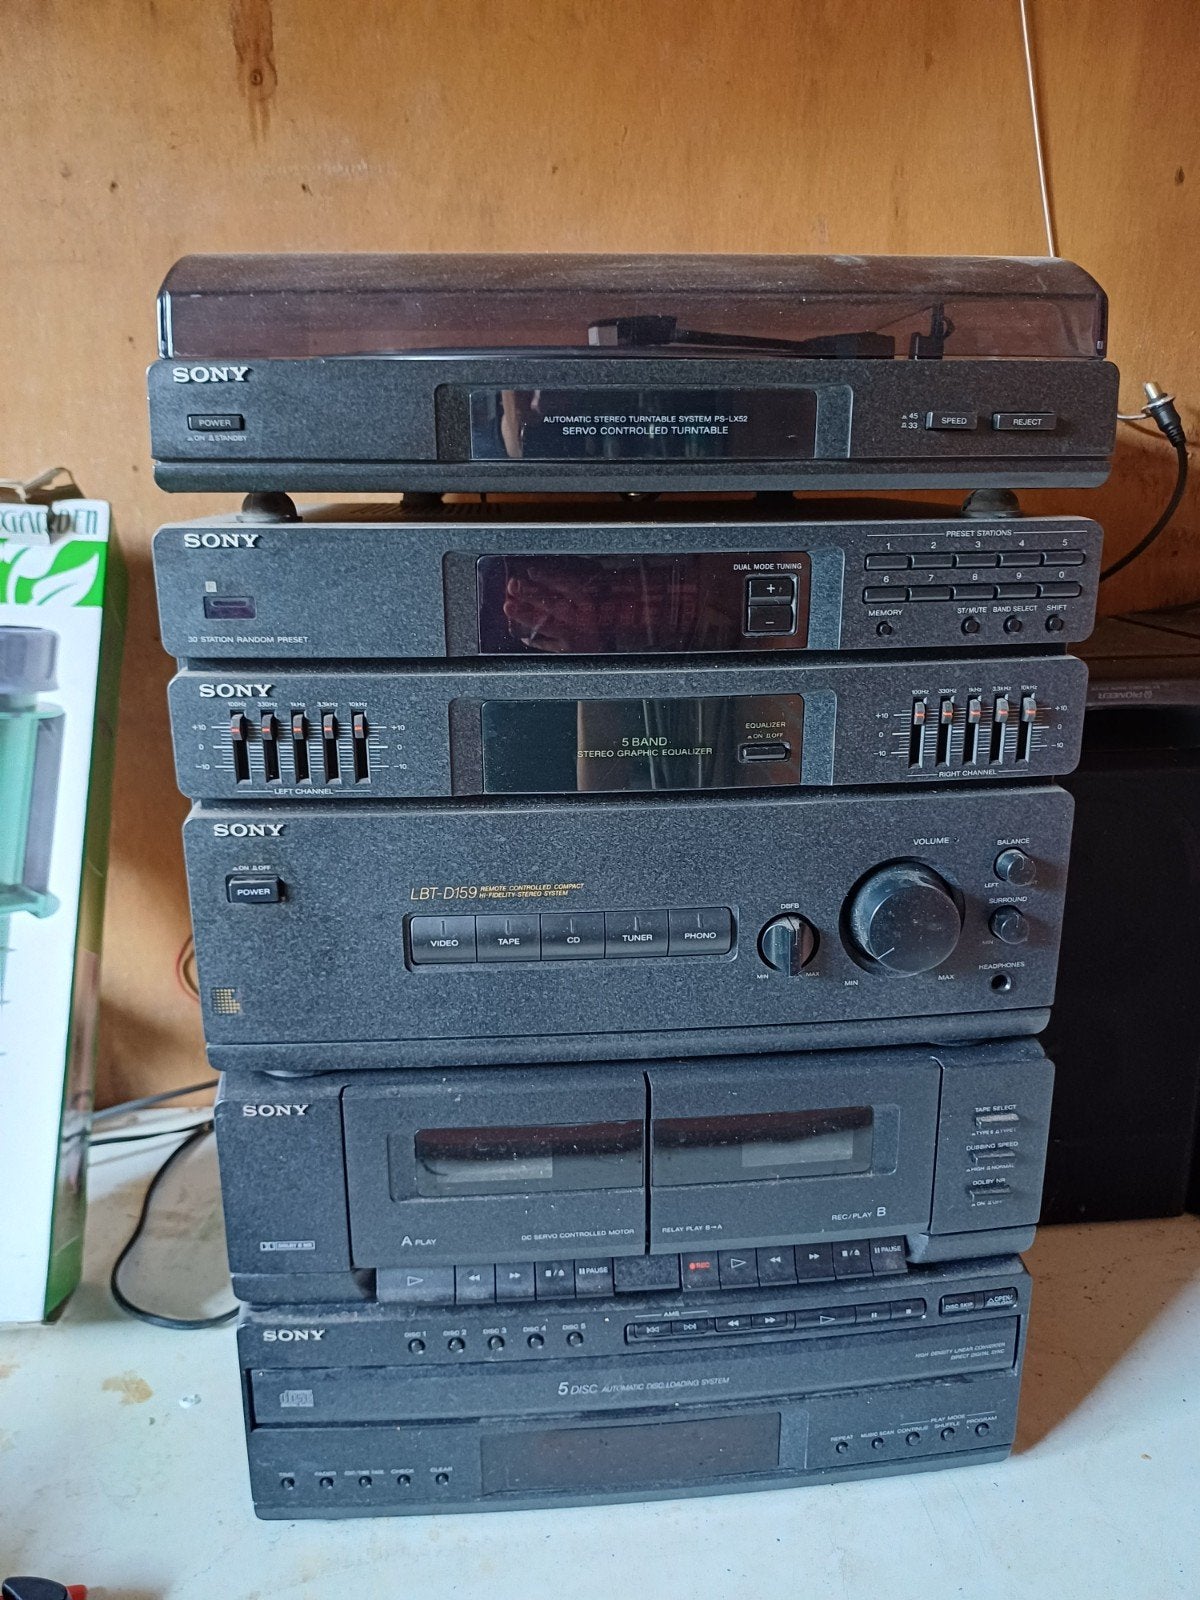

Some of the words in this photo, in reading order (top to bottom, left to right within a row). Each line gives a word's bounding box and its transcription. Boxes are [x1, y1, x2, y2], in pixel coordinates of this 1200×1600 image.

[172, 366, 250, 383] SONY
[942, 417, 968, 425] SPEED
[562, 426, 597, 435] SERVO
[600, 426, 668, 434] CONTROLLED
[671, 426, 728, 434] TURNTABLE
[184, 533, 260, 548] SONY
[199, 684, 272, 698] SONY
[622, 737, 629, 746] 5
[632, 736, 668, 747] BAND
[577, 750, 614, 758] STEREO
[616, 748, 659, 758] GRAPHIC
[662, 748, 713, 756] EQUALIZER
[213, 824, 284, 837] SONY
[913, 836, 950, 846] VOLUME
[996, 838, 1030, 846] BALANCE
[410, 886, 478, 900] LBT-D159
[988, 896, 1028, 904] SURROUND
[622, 934, 653, 942] TUNER
[684, 932, 717, 940] PHONO
[978, 961, 1026, 970] HEADPHONES
[242, 1104, 309, 1117] SONY
[832, 1211, 872, 1222] REC/PLAY
[876, 1206, 887, 1217] B
[534, 1232, 558, 1240] SERVO
[559, 1230, 606, 1239] CONTROLLED
[401, 1236, 412, 1246] A
[415, 1238, 437, 1246] PLAY
[881, 1245, 902, 1254] PAUSE
[586, 1266, 609, 1274] PAUSE
[696, 1261, 711, 1270] REC
[262, 1328, 326, 1342] SONY
[558, 1382, 570, 1396] 5
[570, 1384, 599, 1395] DISC
[601, 1382, 644, 1393] AUTOMATIC
[666, 1380, 700, 1389] LOADING
[701, 1377, 730, 1386] SYSTEM
[897, 1426, 929, 1434] CONTINUE
